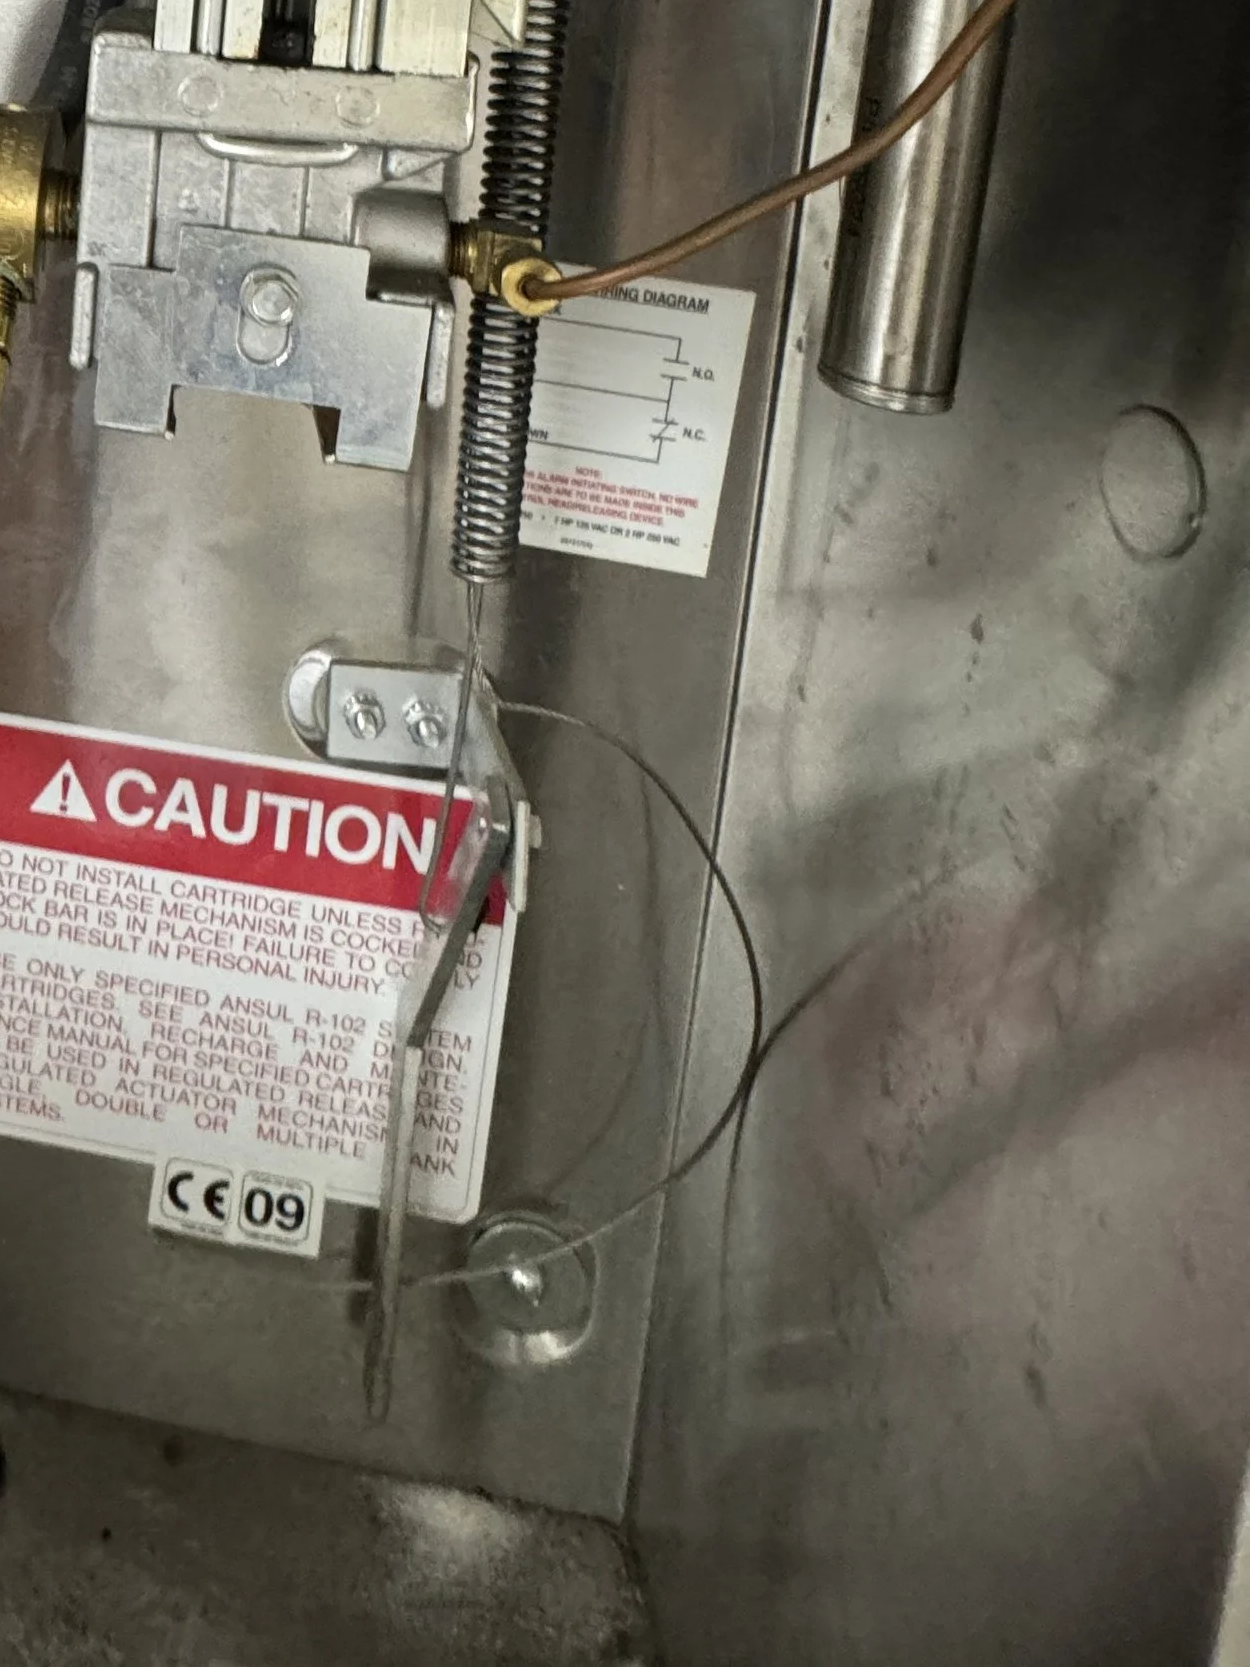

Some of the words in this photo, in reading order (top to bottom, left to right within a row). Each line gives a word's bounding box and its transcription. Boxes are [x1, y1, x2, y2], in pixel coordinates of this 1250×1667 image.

[643, 289, 710, 314] DIAGRAM
[104, 767, 437, 876] CAUTION
[22, 852, 70, 878] NOT
[76, 861, 163, 896] INSTALL
[170, 879, 302, 918] CARTRIDGE
[311, 902, 401, 936] UNLESS
[54, 883, 154, 915] RELEASE
[160, 899, 298, 939] MECHANISM
[304, 924, 324, 945] IS
[44, 899, 89, 924] BAR
[98, 910, 118, 930] IS
[126, 915, 148, 936] IN
[156, 919, 234, 950] PLACE!
[243, 934, 338, 969] FAILURE
[347, 951, 376, 973] TO
[58, 923, 144, 953] RESULT
[148, 940, 170, 961] IN
[176, 943, 298, 984] PERSONAL
[26, 957, 87, 985] ONLY
[94, 969, 212, 1008] SPECIFIED
[219, 994, 295, 1024] ANSUL
[305, 1007, 367, 1035] R-102
[138, 998, 185, 1024] SEE
[199, 1011, 276, 1040] ANSUL
[292, 1026, 356, 1055] R-102
[47, 1023, 138, 1056] MANUAL
[142, 1040, 188, 1066] FOR
[193, 1051, 311, 1087] SPECIFIED
[150, 1021, 280, 1061] RECHARGE
[300, 1049, 349, 1073] AND
[6, 1034, 36, 1056] BE
[46, 1043, 107, 1070] USED
[119, 1057, 141, 1077] IN
[152, 1063, 286, 1103] REGULATED
[299, 1089, 387, 1121] RELEAS
[414, 1110, 462, 1135] AND
[114, 1076, 237, 1117] ACTUATOR
[436, 1135, 459, 1156] IN
[75, 1088, 168, 1123] DOUBLE
[194, 1112, 229, 1135] OR
[256, 1123, 367, 1160] MULTIPLE
[409, 1151, 456, 1178] ANK
[167, 1170, 231, 1221] CE
[244, 1187, 306, 1232] 09
